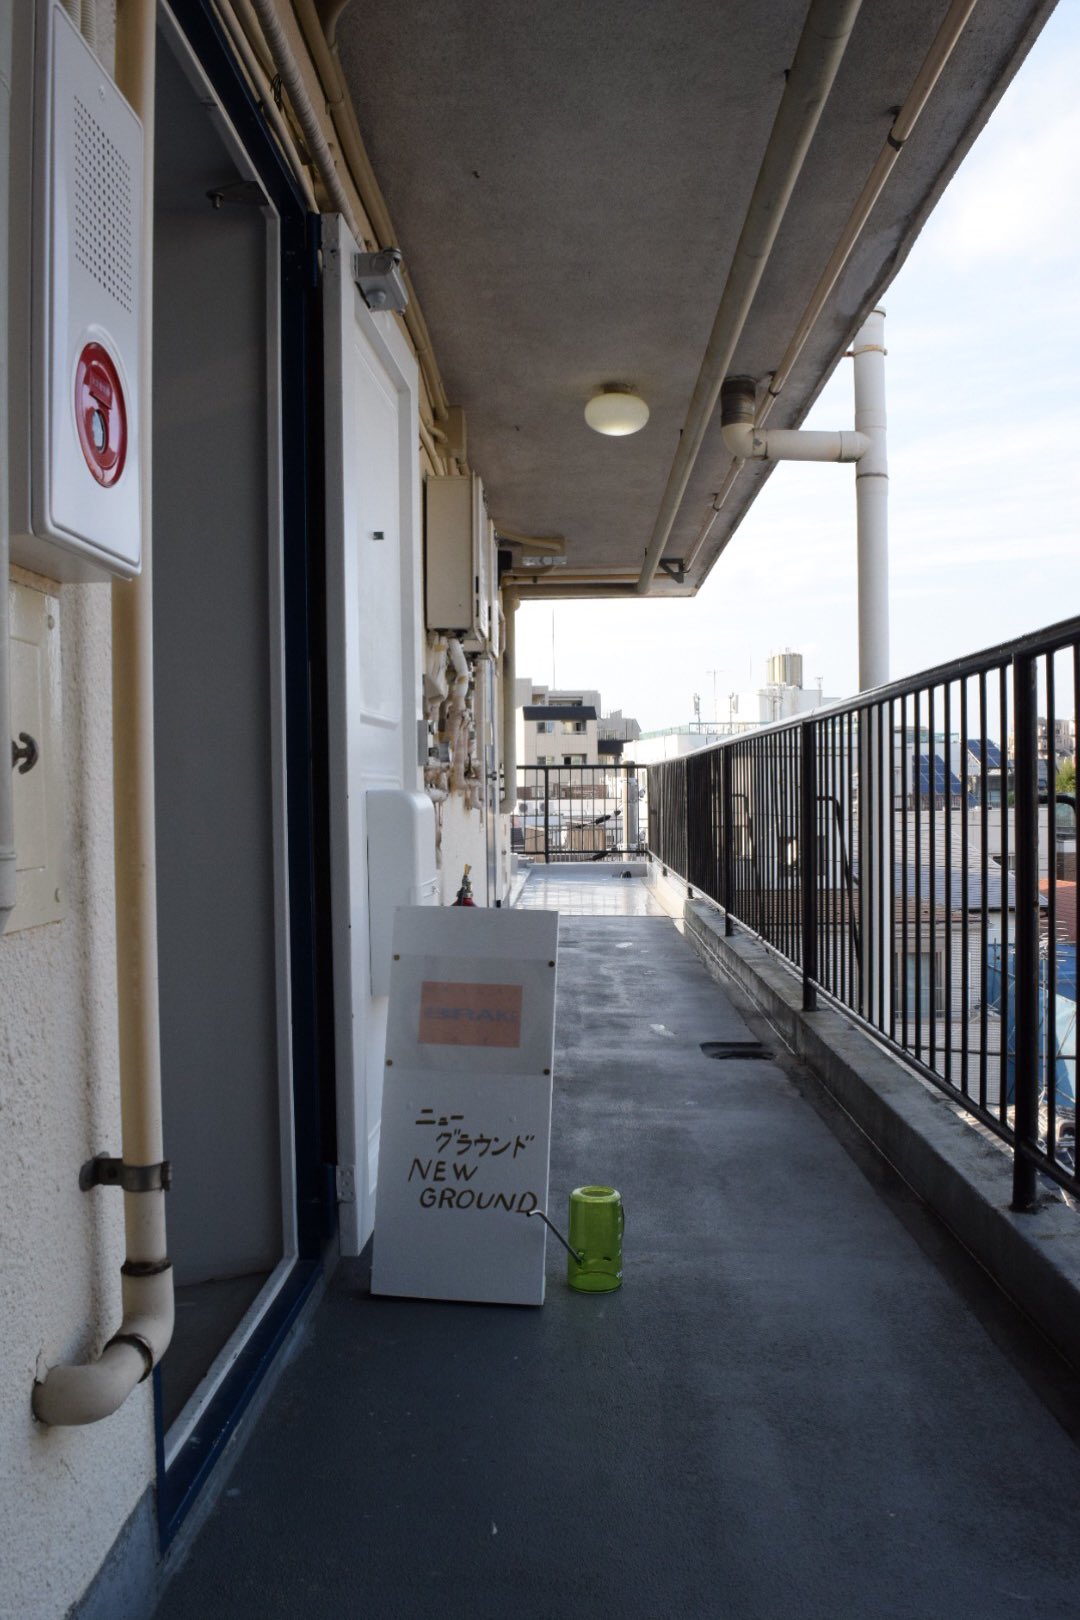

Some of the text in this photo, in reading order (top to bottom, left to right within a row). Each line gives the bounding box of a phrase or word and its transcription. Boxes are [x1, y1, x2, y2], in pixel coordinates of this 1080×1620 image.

[415, 1108, 464, 1126] ニュー
[436, 1129, 535, 1158] グラウンド
[408, 1158, 478, 1182] NEW
[420, 1187, 538, 1213] GROUND
